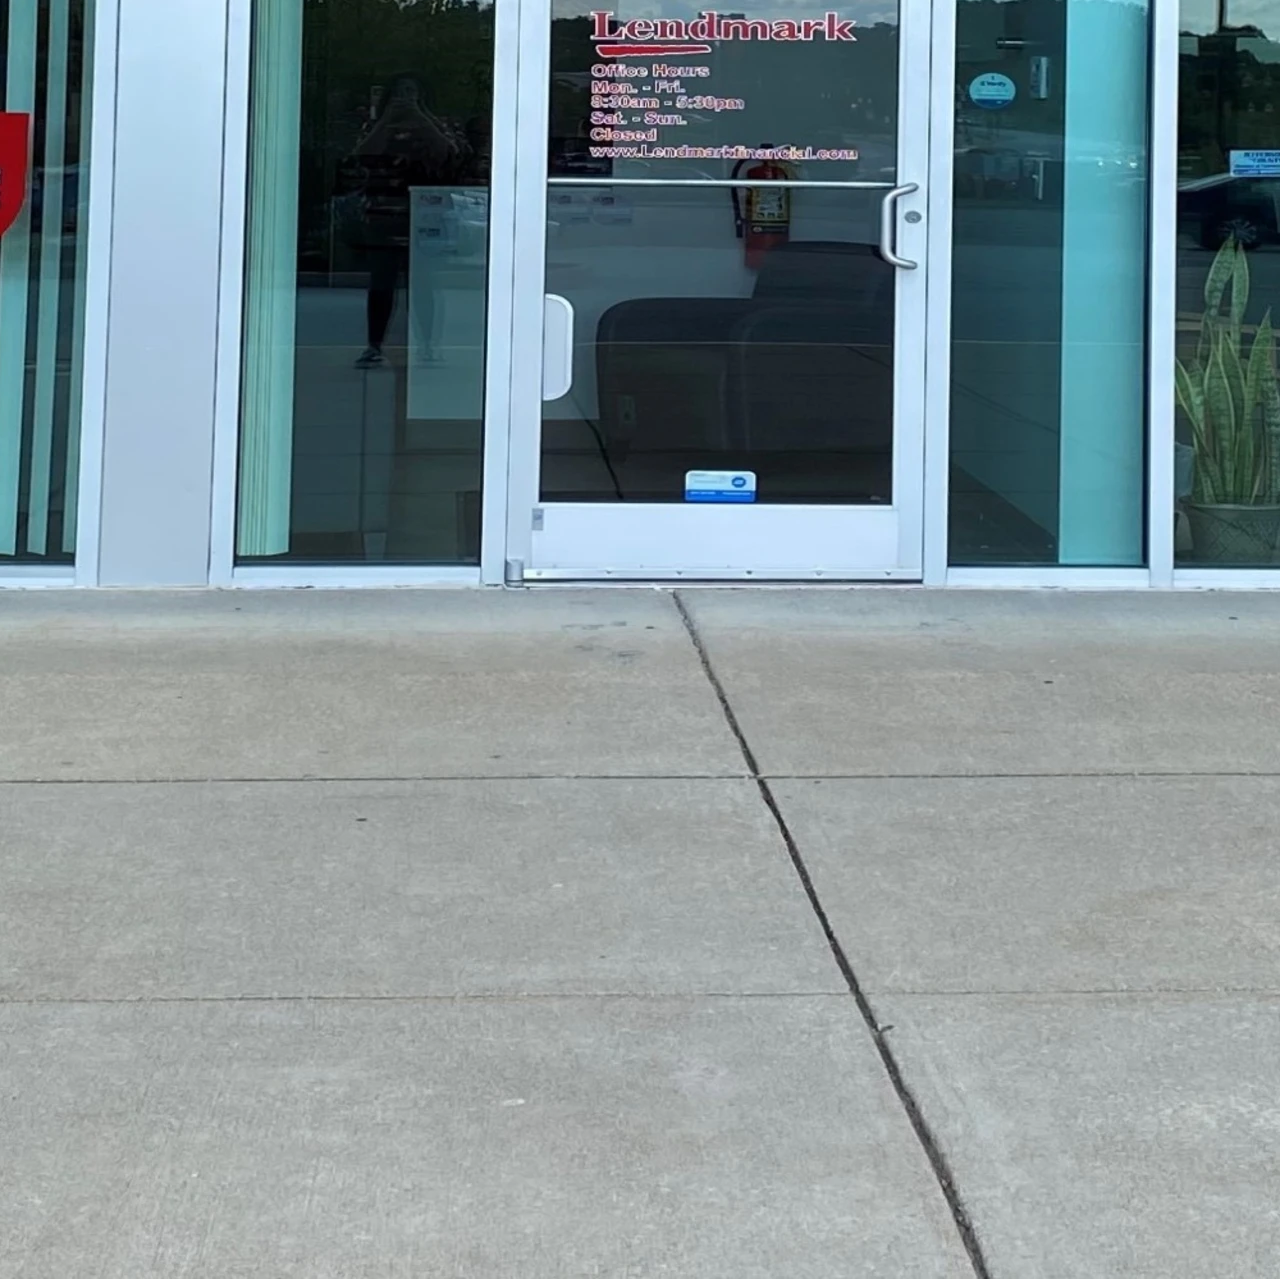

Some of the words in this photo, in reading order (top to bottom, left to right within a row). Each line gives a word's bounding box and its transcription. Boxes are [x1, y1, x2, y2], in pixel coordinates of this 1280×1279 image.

[589, 10, 858, 42] Lendmark
[590, 63, 648, 78] Office
[651, 64, 710, 78] Hours
[590, 80, 638, 94] Mon.
[654, 80, 686, 94] Fri.
[590, 94, 660, 109] 8:30am
[675, 95, 745, 112] 5:30pm
[589, 111, 628, 125] Sat.
[643, 112, 687, 125] Sun.
[589, 127, 658, 141] Closed
[589, 144, 859, 161] www.Lendmarkfinancial.com
